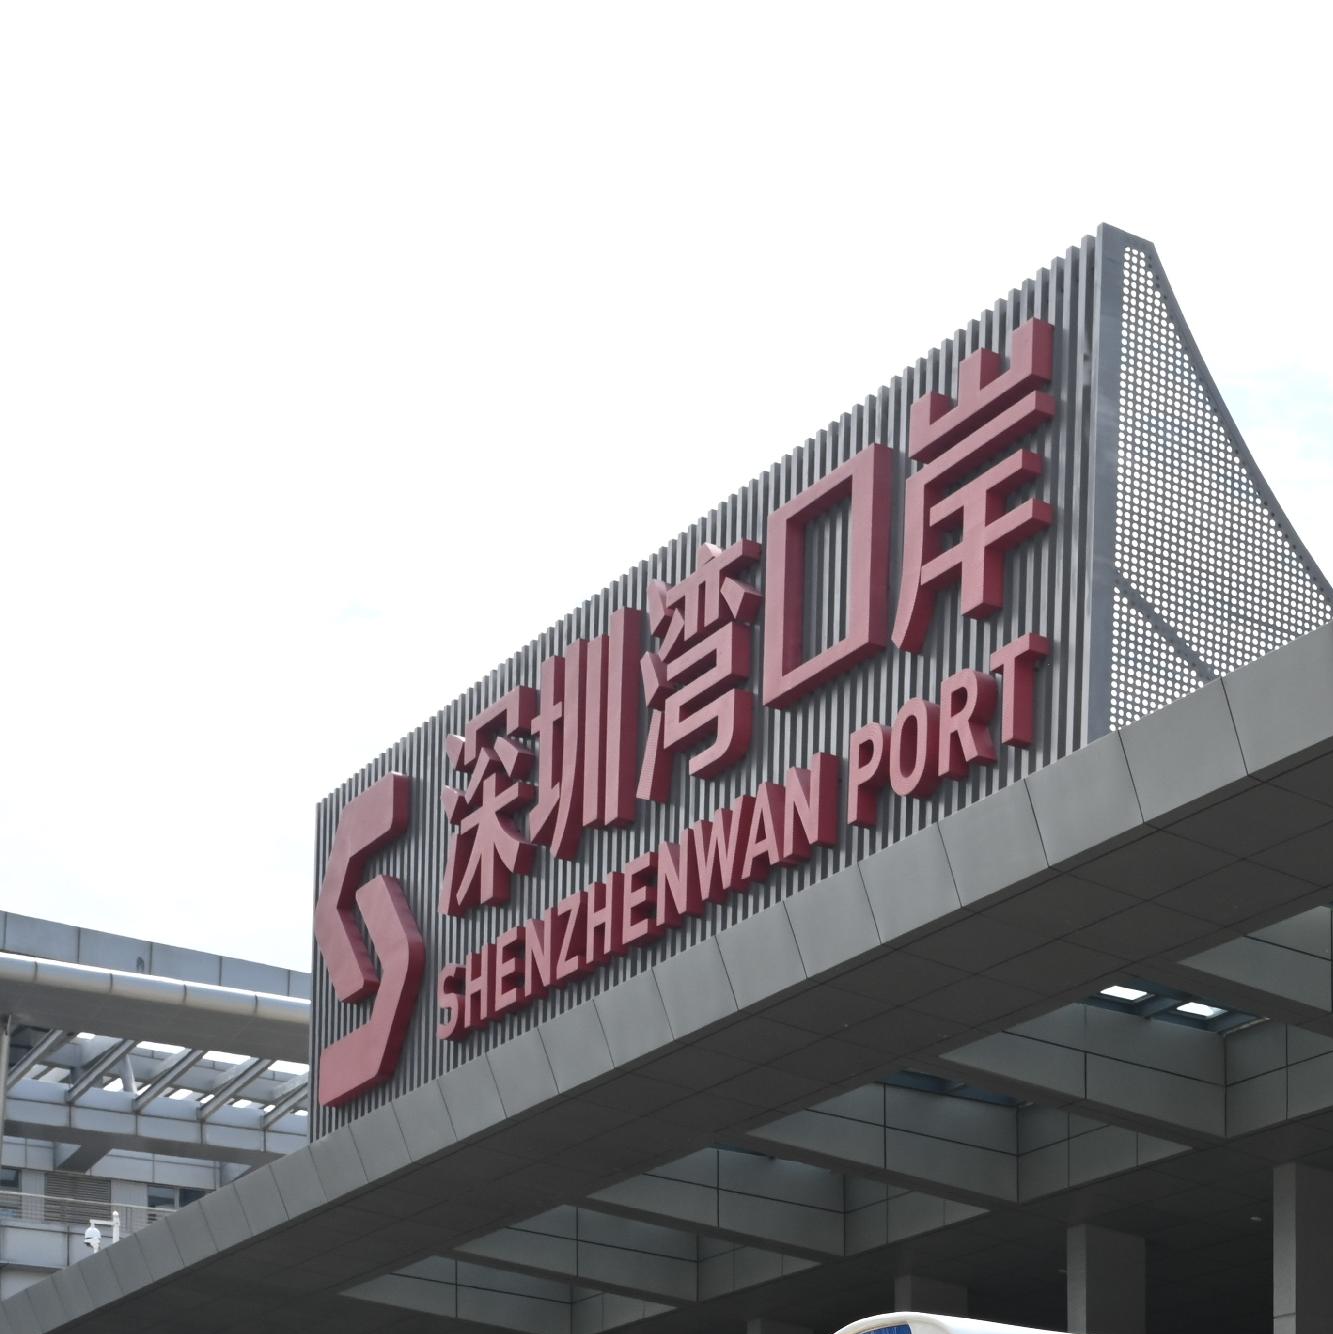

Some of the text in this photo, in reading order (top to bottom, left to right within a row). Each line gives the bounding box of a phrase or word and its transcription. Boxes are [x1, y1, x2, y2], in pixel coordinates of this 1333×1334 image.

[437, 632, 1050, 1042] SHENZHENWAN PORT
[438, 317, 1055, 917] 深圳湾口岸
